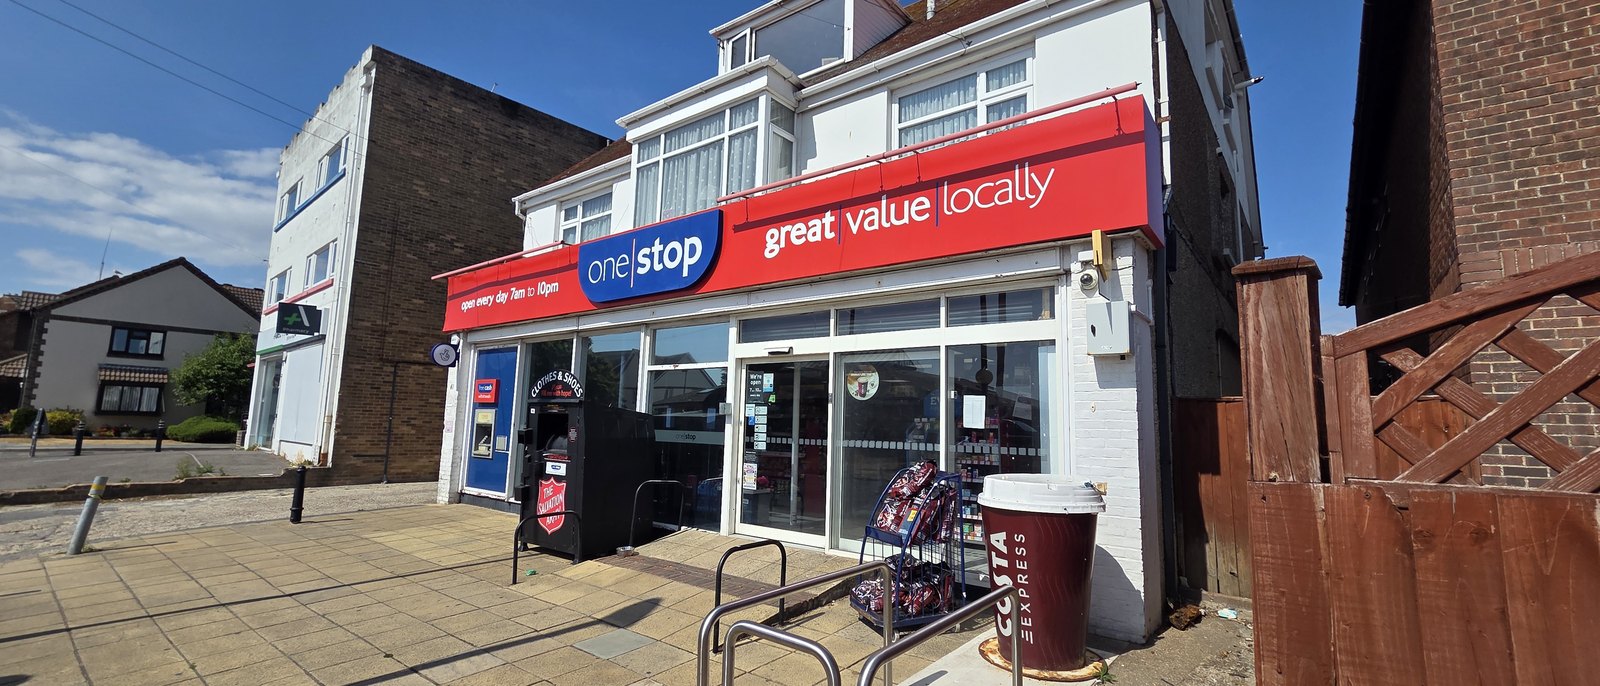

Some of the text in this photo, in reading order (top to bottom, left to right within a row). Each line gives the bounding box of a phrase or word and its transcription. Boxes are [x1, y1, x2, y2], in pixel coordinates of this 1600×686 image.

[763, 161, 1055, 259] great value locally
[636, 235, 702, 278] stop
[461, 281, 559, 312] open every day 7am to 10pm
[531, 371, 583, 398] CLOTHES & SHOES
[538, 493, 563, 514] SALVATION
[543, 485, 554, 499] THE
[1014, 533, 1033, 627] EXPRESS
